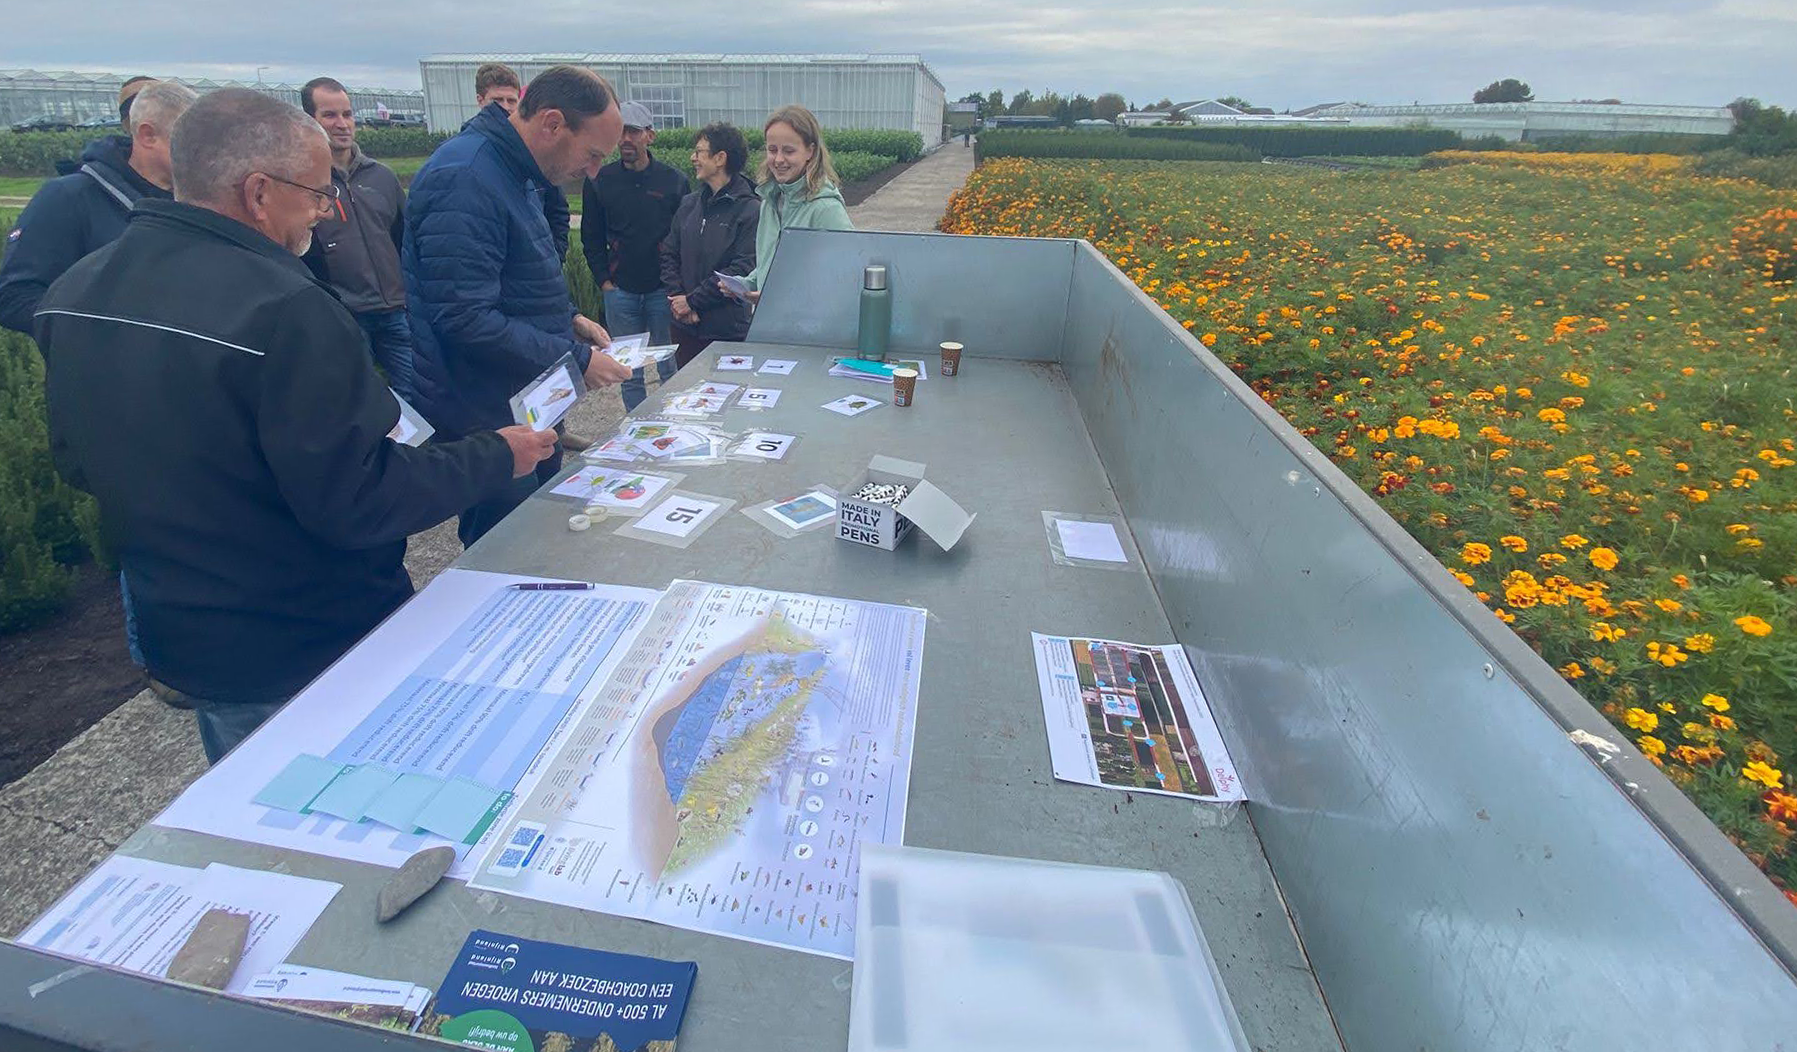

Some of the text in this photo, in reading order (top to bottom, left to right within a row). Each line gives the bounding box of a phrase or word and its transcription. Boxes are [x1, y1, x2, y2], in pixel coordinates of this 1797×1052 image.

[756, 439, 783, 452] 10
[665, 505, 702, 525] 15
[841, 502, 881, 517] MADE IN
[841, 509, 880, 527] ITALY
[841, 526, 880, 545] PENS
[475, 939, 505, 950] Rijnland
[471, 954, 501, 964] Rijnland
[530, 969, 673, 998] EEN COACHBEZOEK AAN
[461, 981, 667, 1019] AL 500+ ONDERNEMERS VROEGEN
[496, 1031, 507, 1040] uw
[508, 1030, 518, 1042] op
